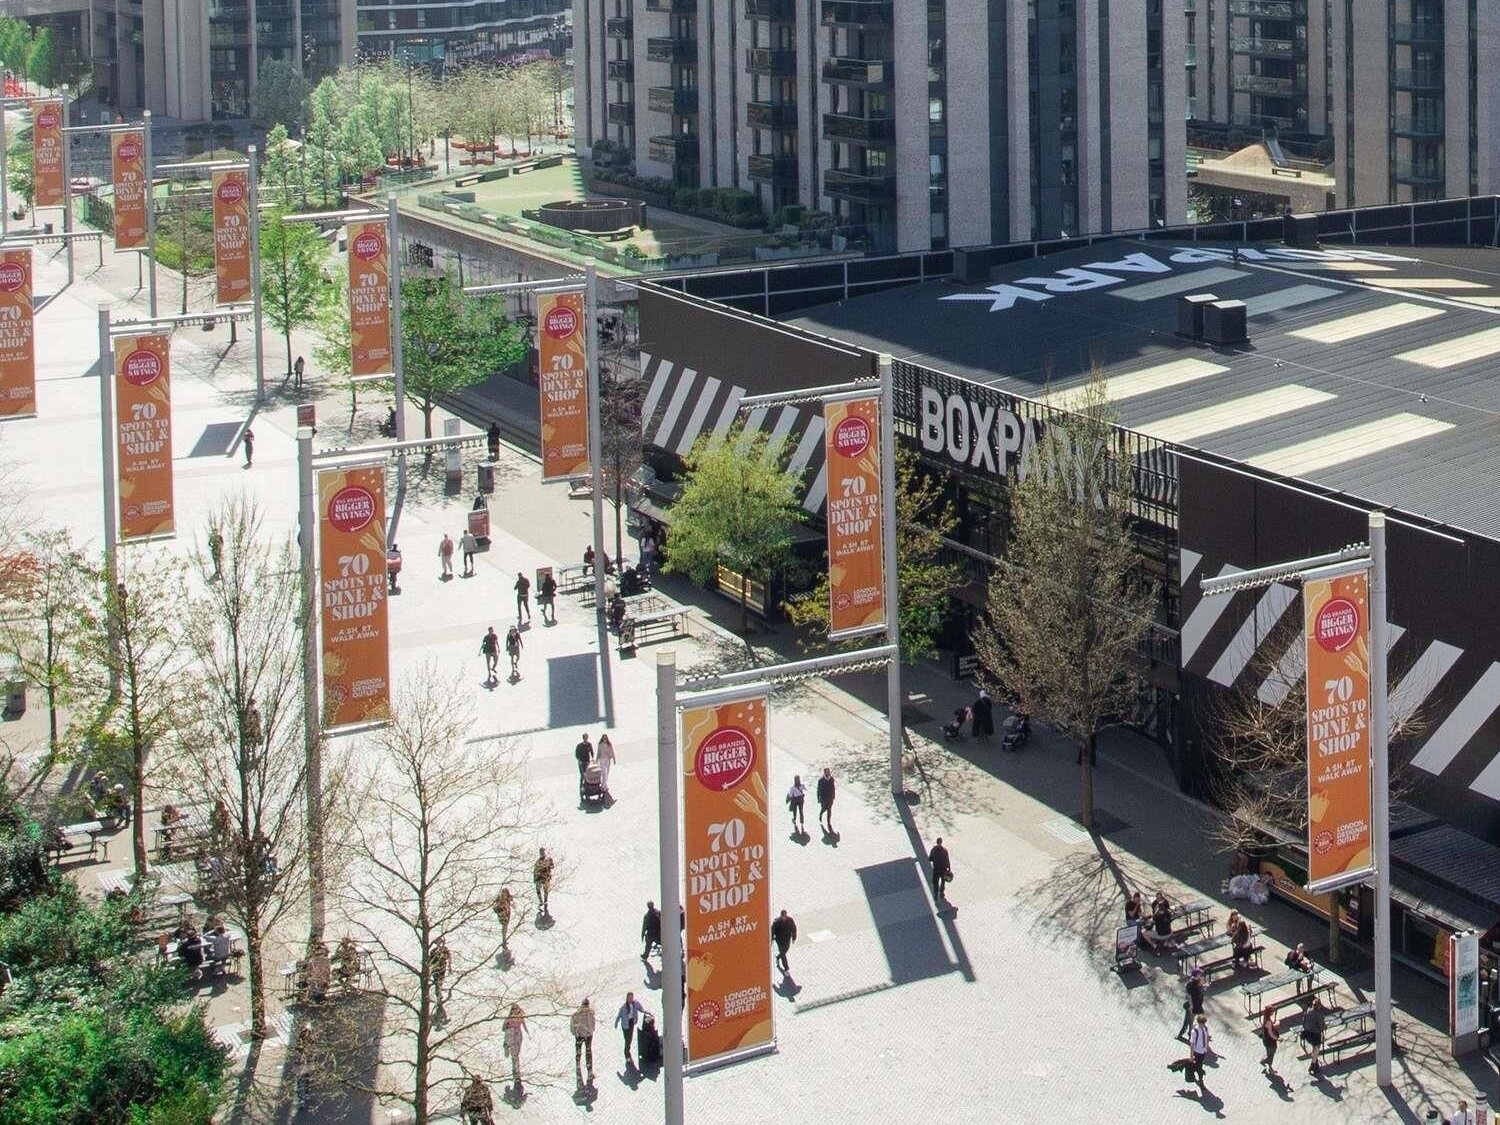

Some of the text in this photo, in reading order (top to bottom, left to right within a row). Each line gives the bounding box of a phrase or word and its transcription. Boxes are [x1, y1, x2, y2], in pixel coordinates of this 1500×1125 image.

[122, 171, 136, 182] 70
[223, 215, 239, 227] 70
[360, 273, 378, 287] 70
[352, 293, 387, 303] DINE &
[356, 302, 383, 313] SHOP
[128, 361, 157, 370] BIGGER
[551, 354, 573, 371] 70
[542, 369, 583, 380] SPOTS TO
[543, 378, 583, 392] DINE &
[547, 389, 579, 402] SHOP
[131, 402, 157, 420] 70
[119, 418, 168, 432] SPOTS TO
[121, 428, 168, 443] DINE &
[838, 429, 866, 440] BIGGER
[838, 437, 866, 448] SAVINGS
[125, 441, 164, 455] SHOP
[841, 475, 866, 497] 70
[335, 500, 370, 513] BIGGER
[830, 494, 878, 511] SPOTS TO
[334, 510, 371, 521] SAVINGS
[831, 504, 877, 524] DINE &
[836, 519, 872, 537] SHOP
[848, 539, 869, 548] SHRT
[338, 553, 369, 577] 70
[324, 573, 383, 592] SPOTS TO
[325, 585, 385, 607] DINE &
[331, 601, 378, 621] SHOP
[346, 624, 372, 635] SHRT
[1320, 614, 1354, 630] BIGGER
[331, 629, 379, 644] WALK AWAY
[1320, 624, 1354, 640] SAVINGS
[1324, 676, 1353, 705] 70
[1311, 698, 1366, 724] SPOTS TO
[1312, 713, 1366, 741] DINE &
[705, 739, 746, 754] BIG BRANDS
[1318, 731, 1361, 758] SHOP
[703, 747, 747, 765] BIGGER
[703, 757, 749, 776] SAVINGS
[1317, 764, 1362, 784] WALK AWAY
[1324, 758, 1356, 774] A SHRT
[1336, 819, 1364, 832] LONDON
[707, 818, 745, 853] 70
[1336, 833, 1360, 845] OUTLET
[689, 844, 764, 876] SPOTS TO
[690, 861, 764, 895] DINE &
[699, 883, 756, 915] SHOP
[707, 915, 749, 933] A SHRT
[697, 921, 759, 945] WALK AWAY
[724, 985, 761, 1002] LONDON
[724, 991, 768, 1010] DESIGNER
[724, 1002, 756, 1018] OUTLET
